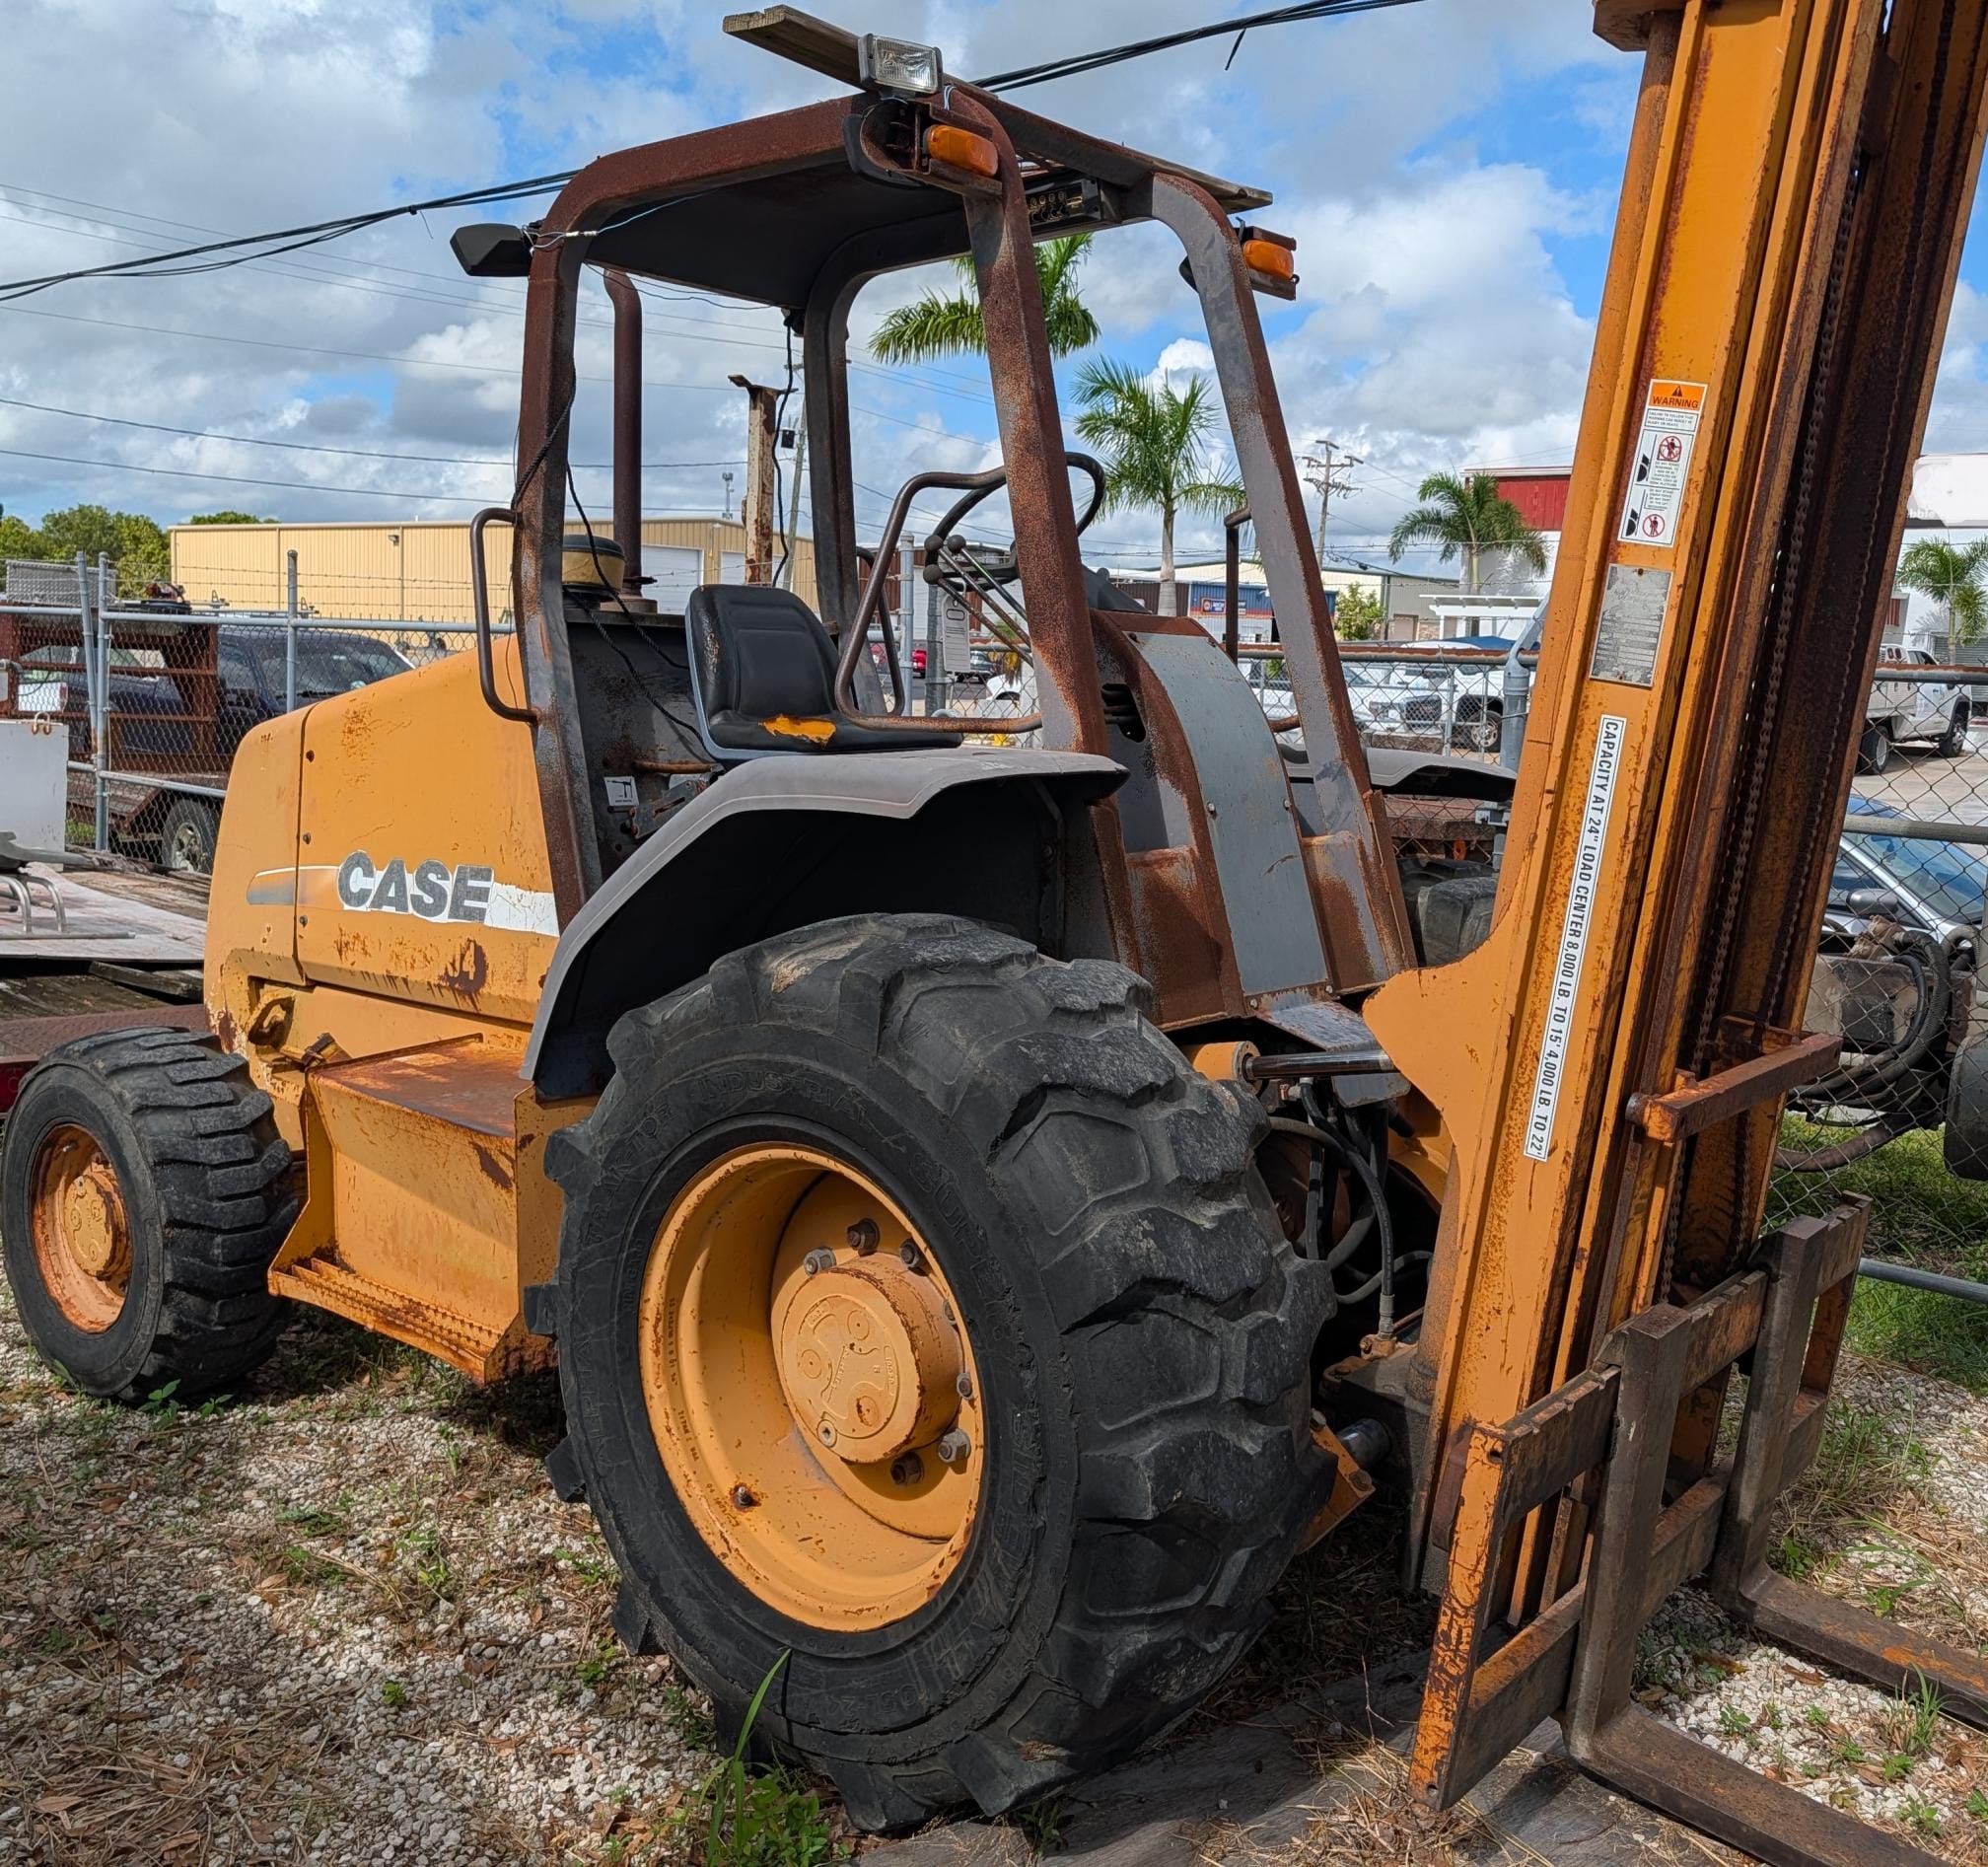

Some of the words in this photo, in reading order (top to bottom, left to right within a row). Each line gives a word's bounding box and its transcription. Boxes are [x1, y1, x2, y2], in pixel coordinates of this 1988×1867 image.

[1653, 395, 1698, 409] WARNING
[1594, 721, 1618, 791] CAPACITY
[1590, 794, 1605, 814] AT
[1585, 817, 1601, 841] 24"
[1578, 844, 1597, 881] LOAD
[337, 849, 495, 923] CASE
[1568, 885, 1589, 938] CENTER
[1560, 940, 1579, 977] 8,000
[1557, 981, 1572, 1001] LB.
[1553, 1004, 1567, 1023] TO
[1549, 1028, 1563, 1047] 15'
[1541, 1048, 1559, 1087] 4,000
[1537, 1089, 1552, 1111] LB.
[1534, 1113, 1548, 1131] TO
[1529, 1133, 1544, 1155] 22'
